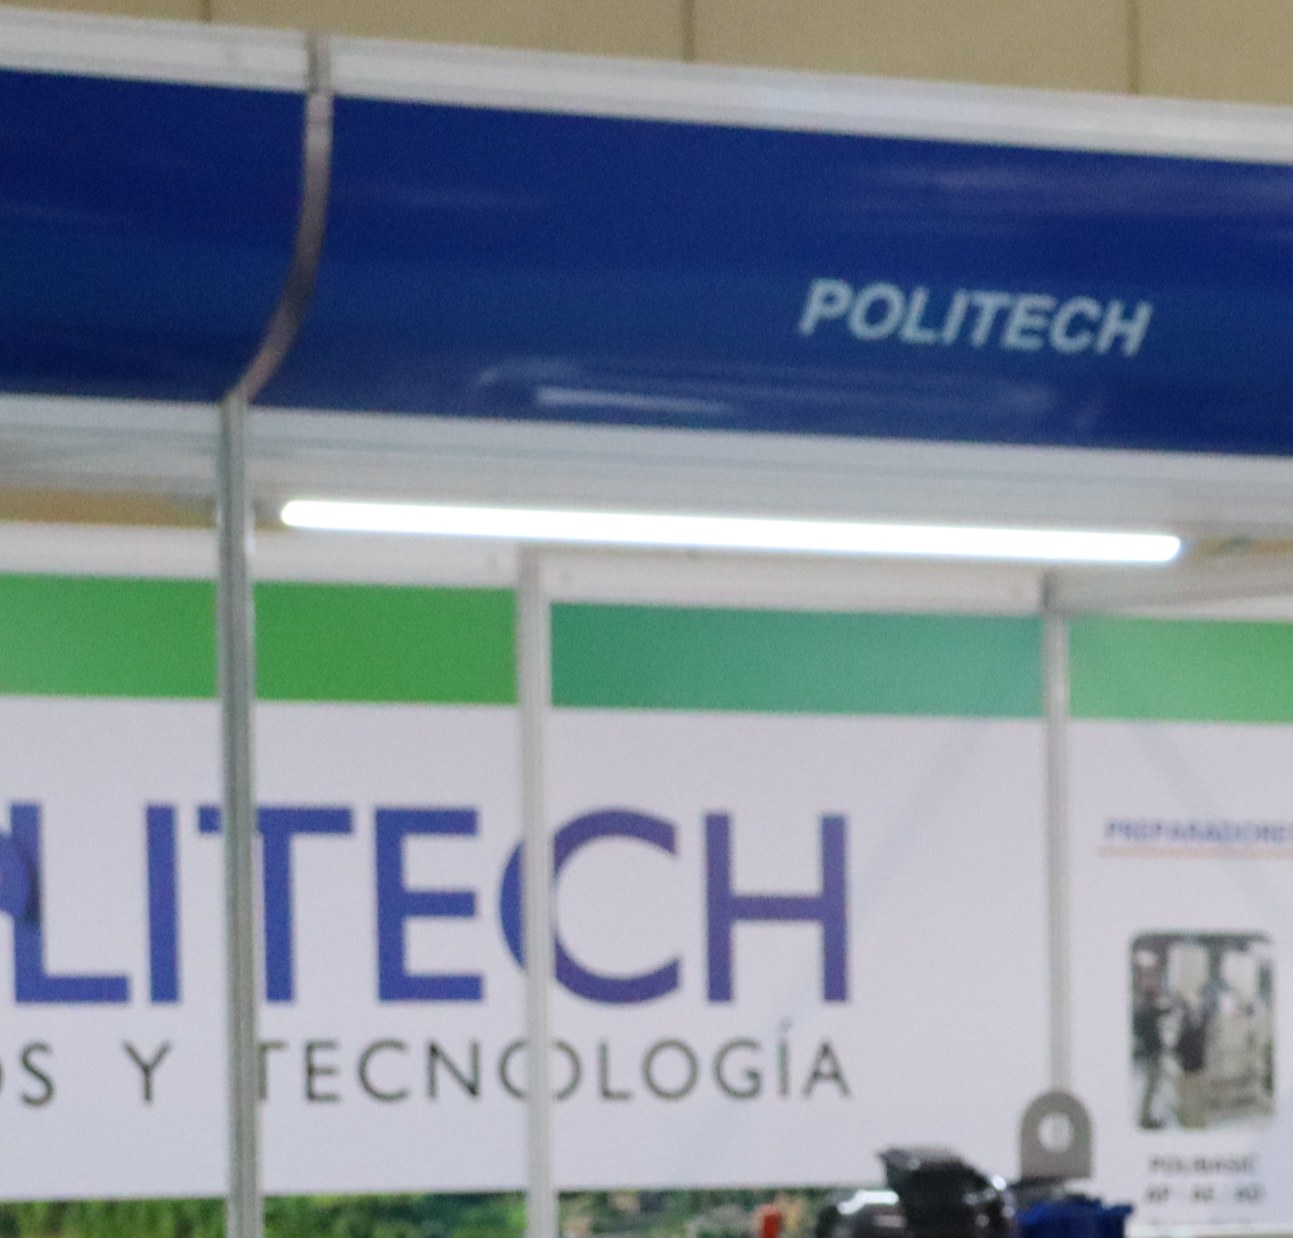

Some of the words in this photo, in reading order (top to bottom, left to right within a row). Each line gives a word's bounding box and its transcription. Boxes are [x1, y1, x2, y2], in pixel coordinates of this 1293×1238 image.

[799, 278, 1154, 357] POLITECH
[0, 802, 850, 1004] LITECH
[123, 1040, 173, 1104] Y
[255, 1019, 853, 1104] TECNOLOGÍA
